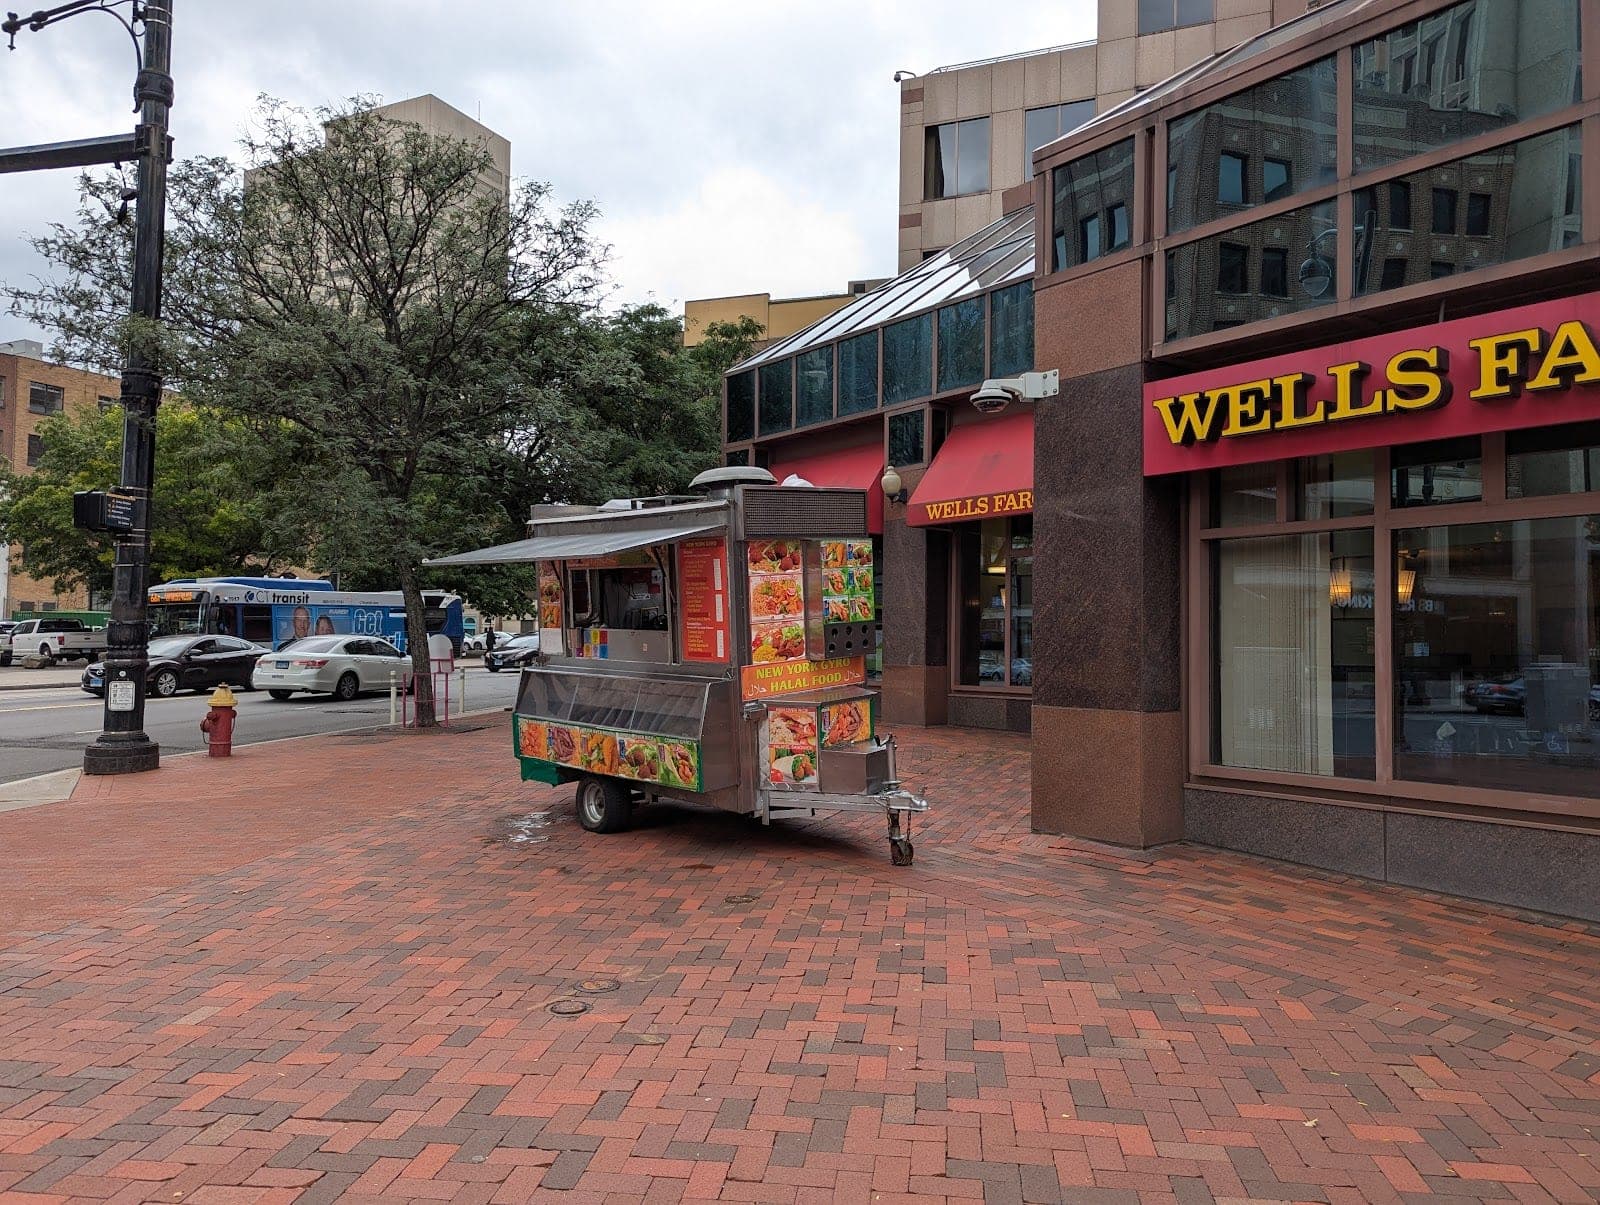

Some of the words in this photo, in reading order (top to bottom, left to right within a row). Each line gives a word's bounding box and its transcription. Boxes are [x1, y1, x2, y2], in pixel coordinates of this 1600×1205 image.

[1153, 346, 1449, 445] WELLS
[926, 496, 989, 520] WELLS
[993, 490, 1034, 512] FAR
[272, 591, 310, 604] transit
[353, 608, 383, 635] Get
[756, 667, 784, 680] NEW
[786, 661, 818, 676] YORK
[820, 657, 851, 670] GYRO
[770, 677, 810, 693] HALAL
[812, 672, 842, 686] FOOD
